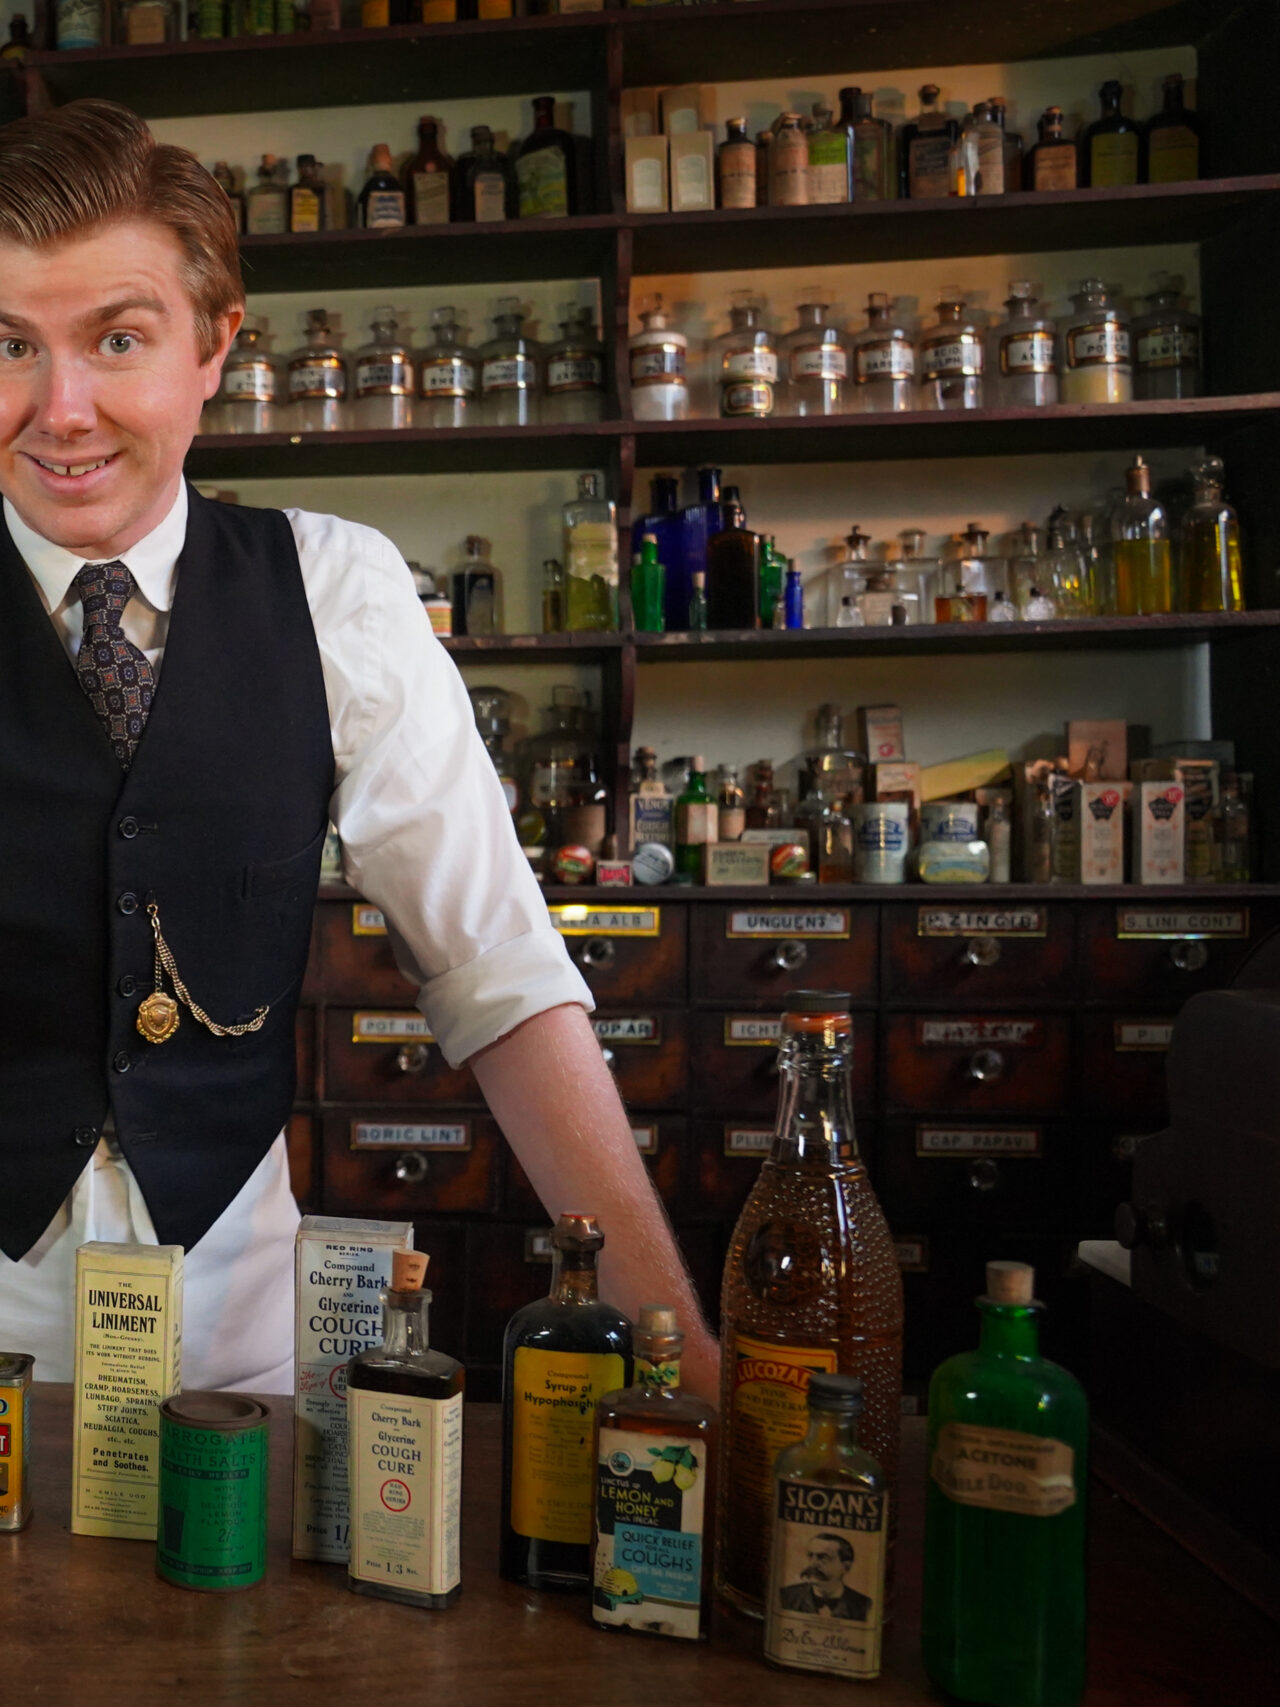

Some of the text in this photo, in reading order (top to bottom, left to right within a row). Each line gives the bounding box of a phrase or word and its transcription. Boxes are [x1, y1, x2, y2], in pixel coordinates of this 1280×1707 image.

[747, 915, 827, 929] UNGUENT
[366, 1021, 393, 1033] POT
[359, 1126, 462, 1141] BORIC LINT
[349, 1245, 374, 1253] RING
[324, 1259, 375, 1273] Compound
[309, 1270, 389, 1290] Cherry Bark
[88, 1289, 162, 1312] UNIVERSAL
[319, 1296, 380, 1315] Glycerine
[93, 1311, 157, 1334] LINIMENT
[309, 1315, 385, 1337] COUGH
[102, 1344, 126, 1352] LINIMENT
[319, 1337, 376, 1357] CURE
[113, 1353, 136, 1361] WITHOUT
[97, 1374, 148, 1387] RHEUMATISM,
[545, 1380, 593, 1394] Syrup of
[84, 1382, 161, 1398] CRAMP, HOARSENESS,
[86, 1393, 160, 1408] LUMBAGO, SPRAINS,
[524, 1391, 596, 1409] Hypophosphi
[97, 1404, 149, 1416] STIFF JOINTS,
[105, 1414, 141, 1426] SCIATICA,
[371, 1411, 421, 1428] Cherry Bark
[128, 1428, 161, 1439] COUGHS,
[378, 1430, 416, 1446] Glycerine
[93, 1447, 150, 1462] Penetrates
[209, 1452, 257, 1467] SALTS
[371, 1444, 421, 1462] COUGH
[958, 1448, 1037, 1471] ACETONE
[93, 1458, 150, 1472] and Soothes.
[378, 1459, 415, 1476] CURE
[600, 1485, 675, 1508] LEMON AND
[785, 1486, 879, 1517] SLOAN'S
[616, 1501, 660, 1518] HONEY
[784, 1507, 878, 1531] LINIMENT
[334, 1524, 350, 1544] 1/
[621, 1530, 694, 1551] QUICK RELIEF
[622, 1547, 693, 1572] COUGHS
